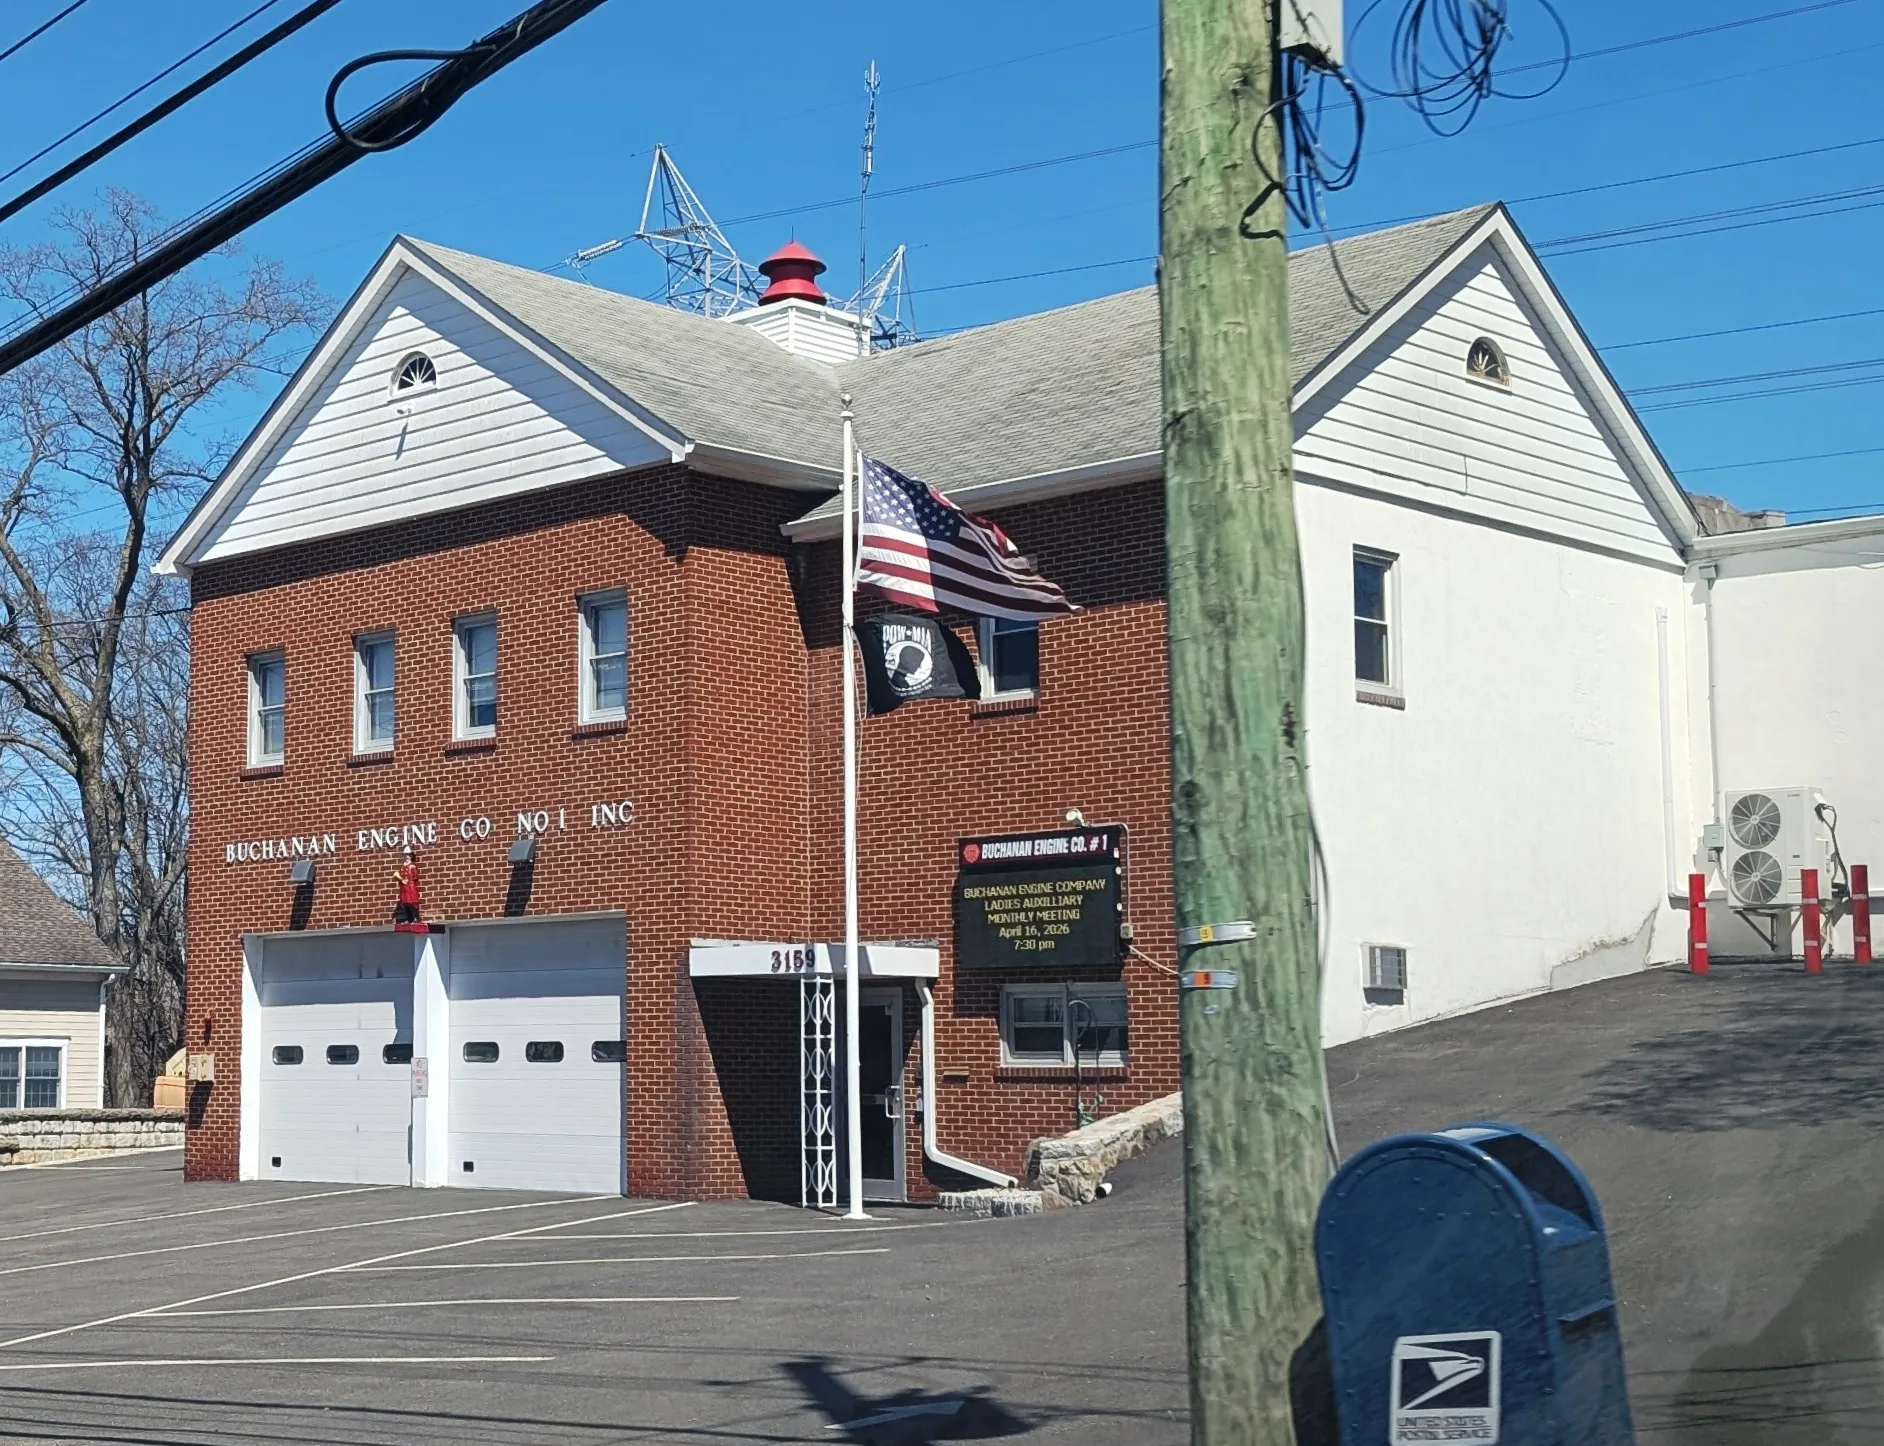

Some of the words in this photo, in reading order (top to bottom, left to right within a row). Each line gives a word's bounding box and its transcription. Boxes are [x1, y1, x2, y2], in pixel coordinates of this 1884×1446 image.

[882, 624, 907, 654] POW
[225, 833, 337, 864] BUCHANAN
[358, 822, 438, 851] ENGINE
[460, 816, 491, 840] CO
[516, 810, 549, 834] NO
[591, 801, 634, 827] INC
[981, 840, 1032, 860] BUCHANAN
[1034, 838, 1069, 856] ENGINE
[1071, 835, 1088, 853] CO.
[963, 885, 1017, 899] BUCHANAN
[1019, 882, 1054, 895] ENGINE
[1056, 879, 1106, 892] COMPANY
[984, 899, 1021, 911] LADIES
[987, 911, 1033, 924] MONTHLY
[1036, 909, 1080, 922] MEETING
[999, 926, 1022, 939] April
[1025, 925, 1041, 937] 16,
[1043, 924, 1070, 936] 2026
[1014, 939, 1036, 950] 7:30
[1038, 940, 1055, 952] pm
[771, 949, 816, 970] 3159
